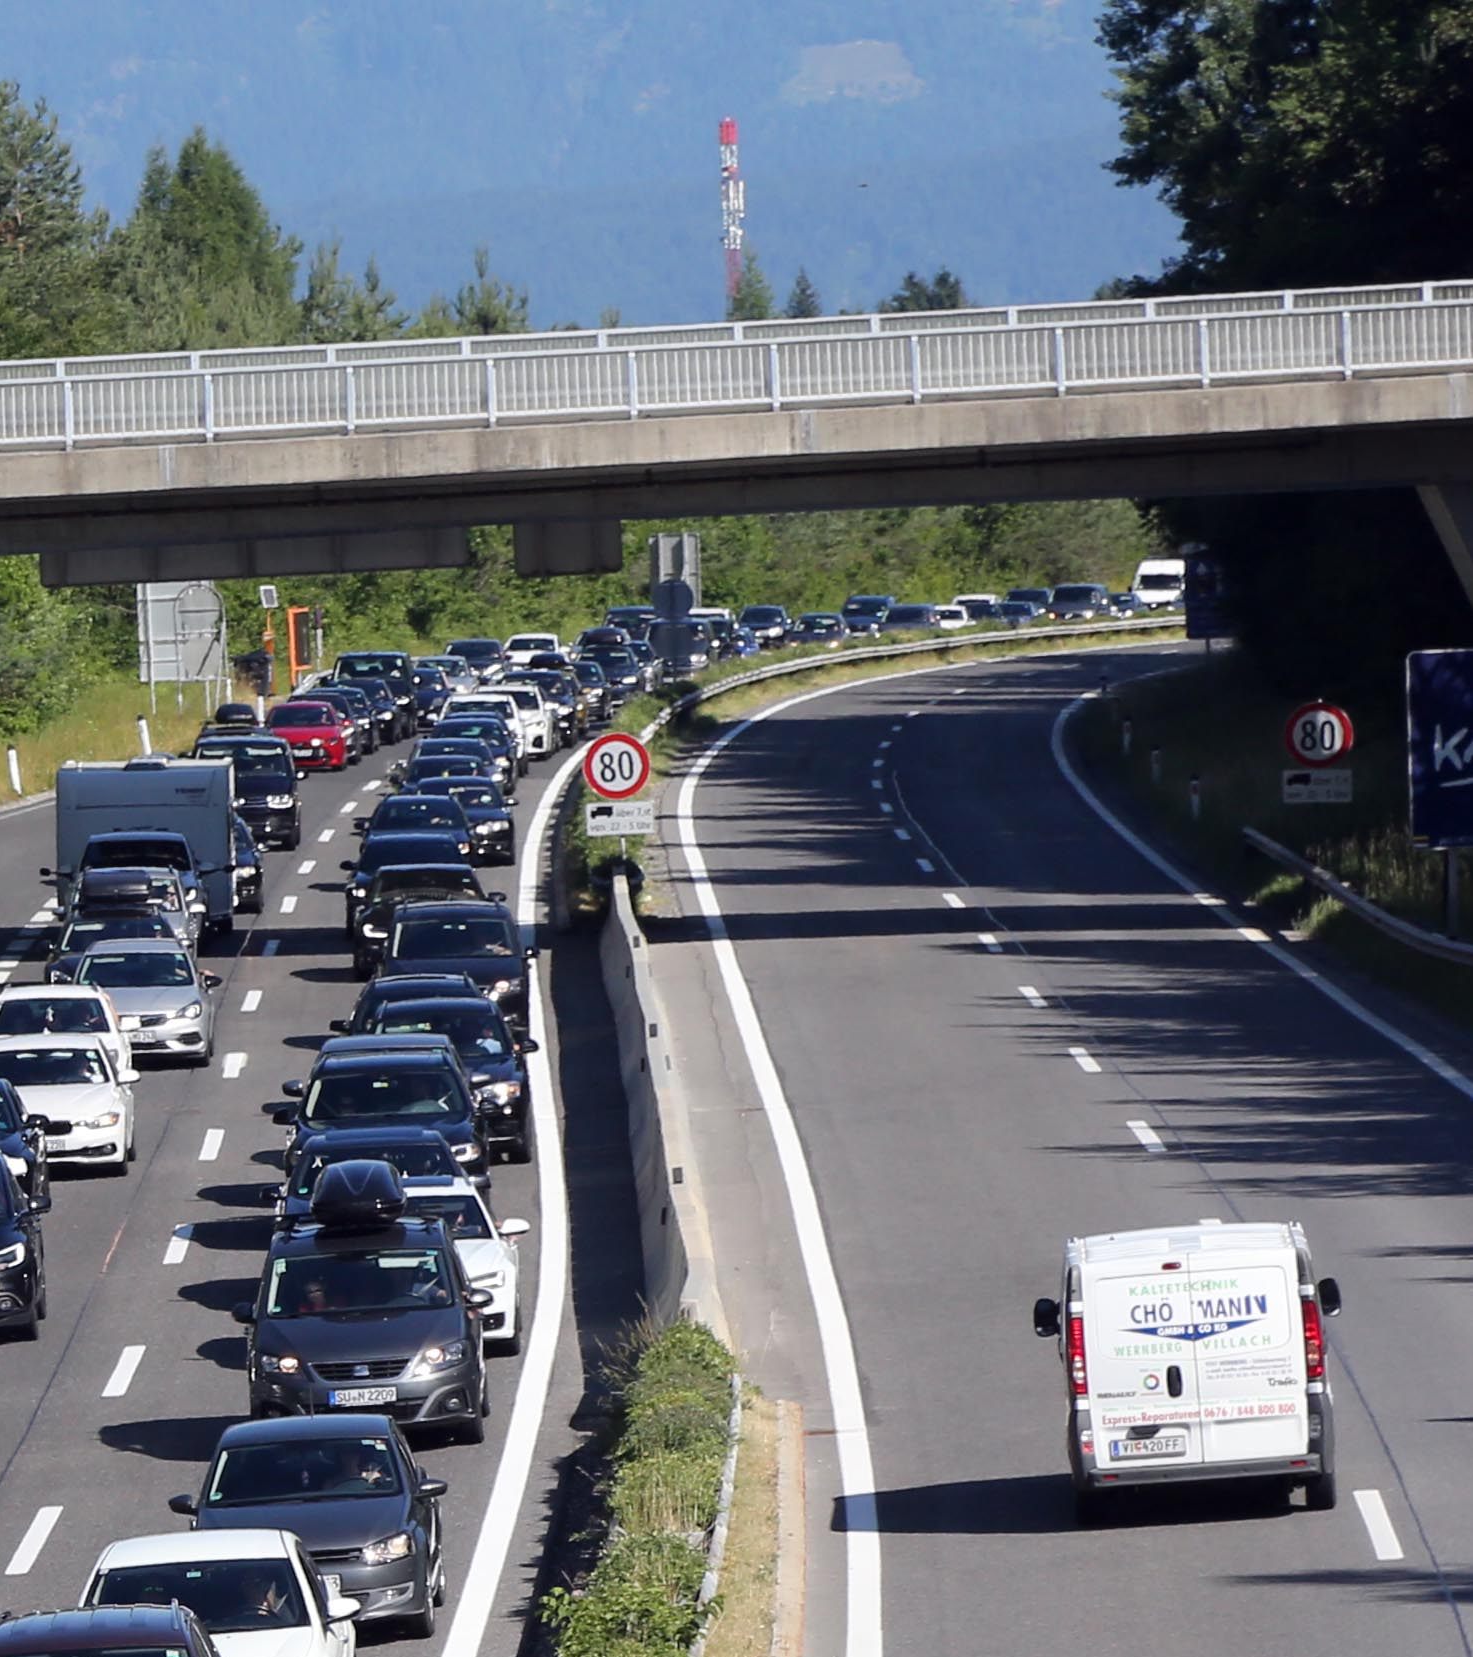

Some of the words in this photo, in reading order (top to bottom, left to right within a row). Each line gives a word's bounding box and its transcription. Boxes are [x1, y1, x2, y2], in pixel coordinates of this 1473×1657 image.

[1301, 720, 1335, 751] 80
[600, 751, 634, 782] 80
[1114, 1343, 1183, 1357] WERNBERG
[1203, 1335, 1271, 1350] VILLACH
[367, 1389, 394, 1401] 2209
[1204, 1405, 1228, 1417] 0676
